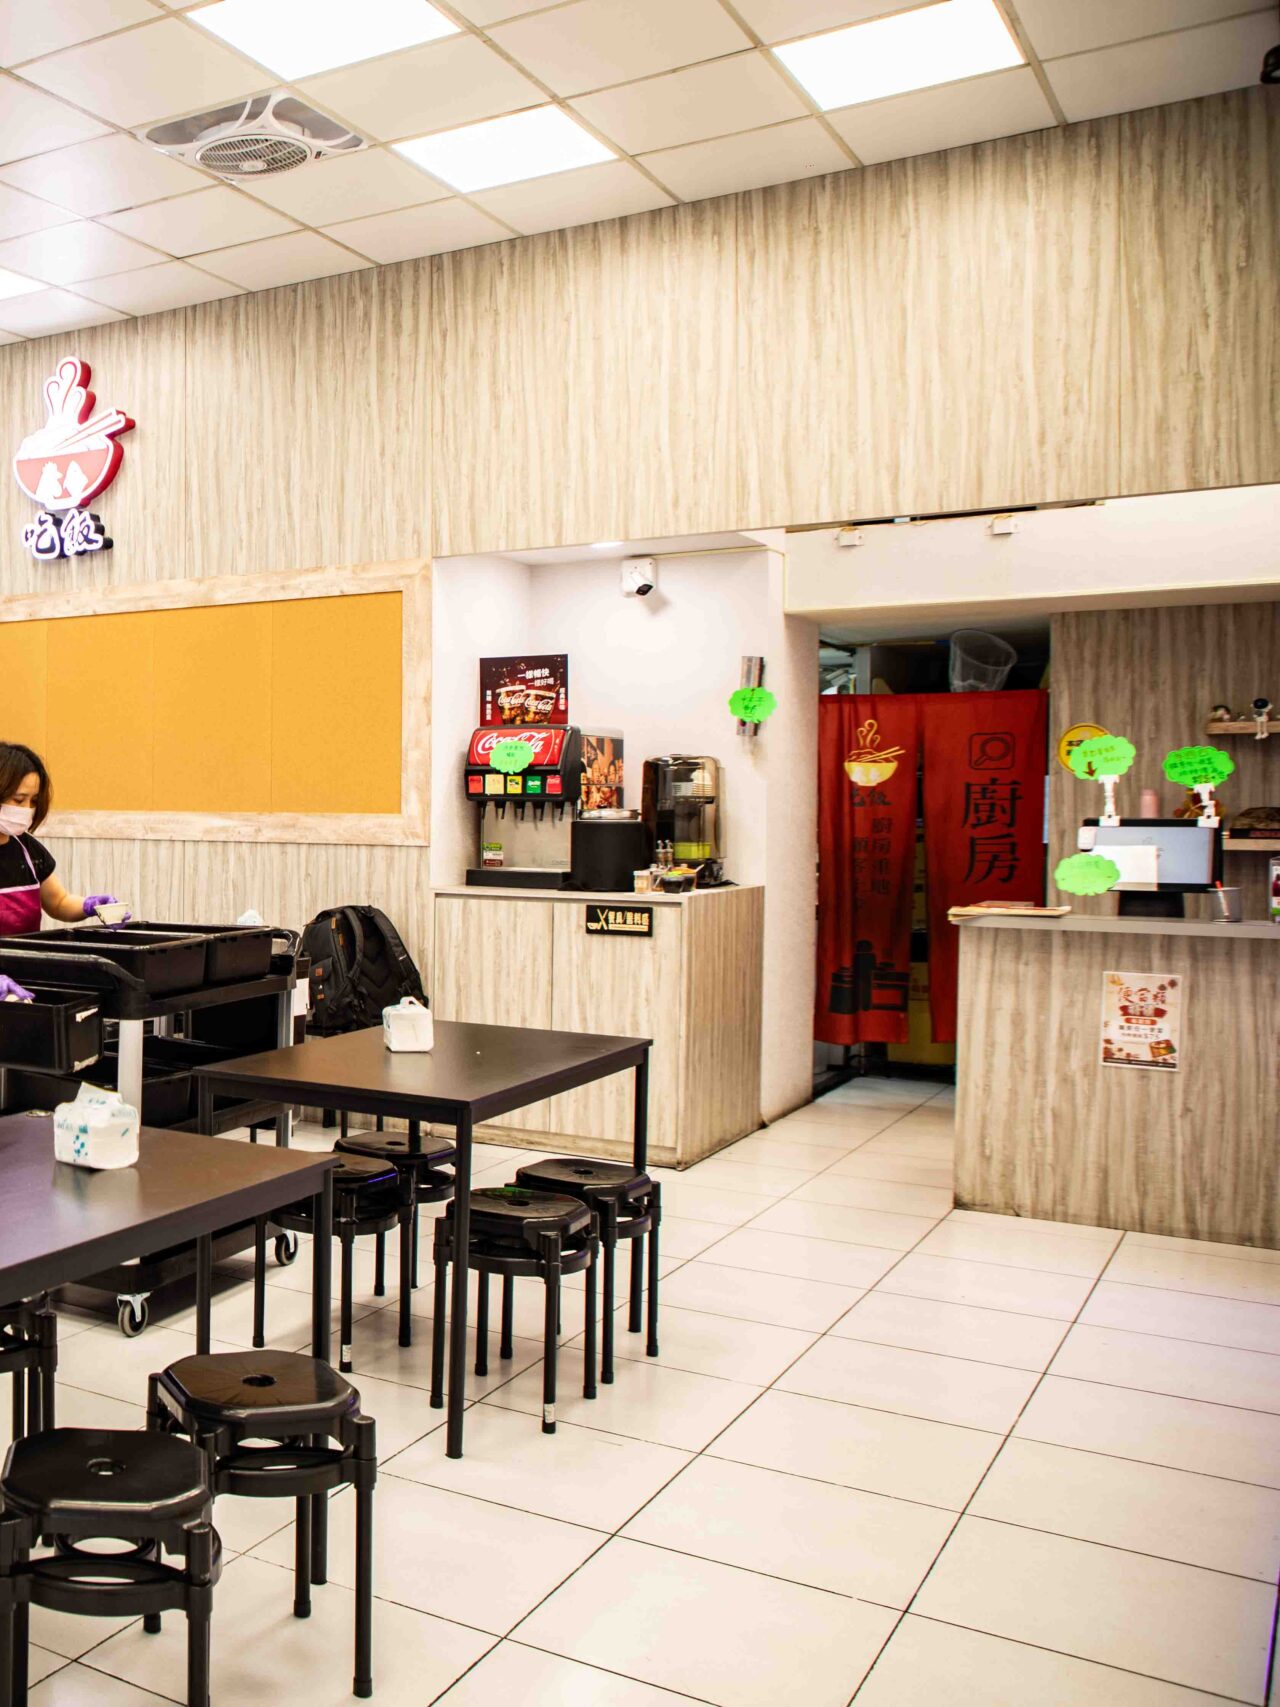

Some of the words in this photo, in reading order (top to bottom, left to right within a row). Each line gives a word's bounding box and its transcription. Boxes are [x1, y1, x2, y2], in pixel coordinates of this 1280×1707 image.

[477, 731, 551, 754] CoCla
[871, 817, 893, 895] 廚房重地
[961, 777, 1024, 885] 廚房
